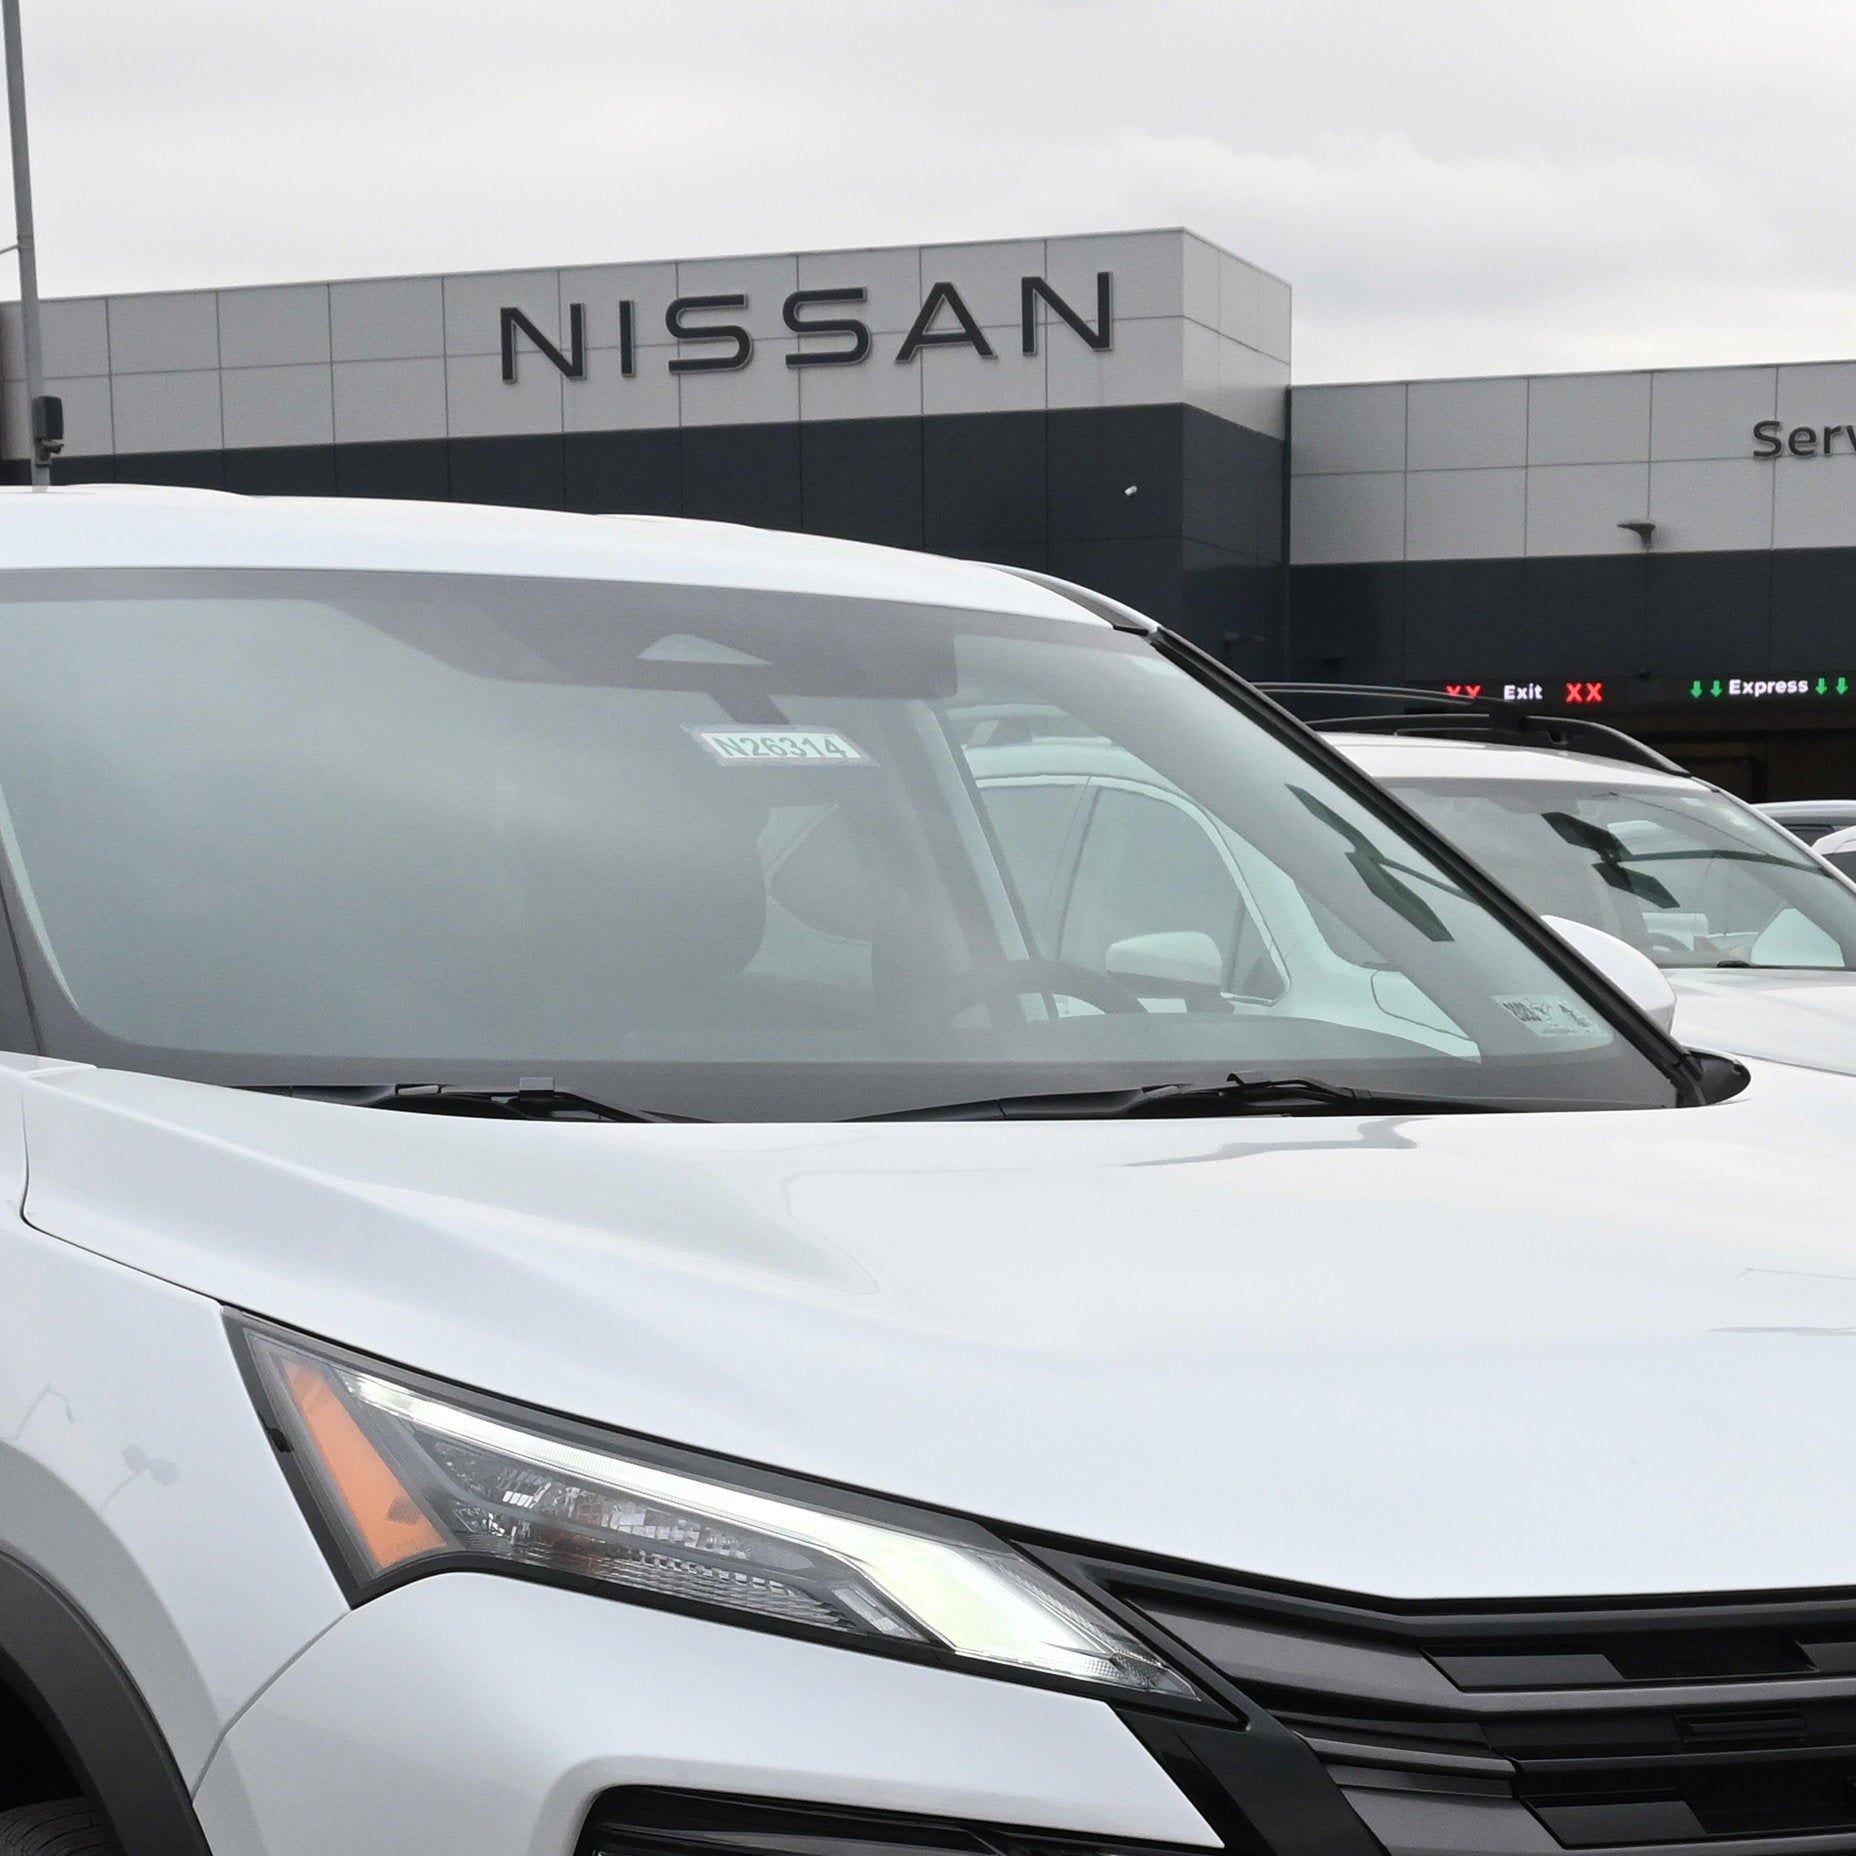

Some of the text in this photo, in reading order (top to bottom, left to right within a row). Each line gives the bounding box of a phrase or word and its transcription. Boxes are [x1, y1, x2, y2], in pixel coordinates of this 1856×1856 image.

[500, 271, 1114, 382] NISSAN
[1503, 684, 1543, 700] Exit
[1728, 678, 1809, 698] Express
[714, 733, 847, 758] N26314
